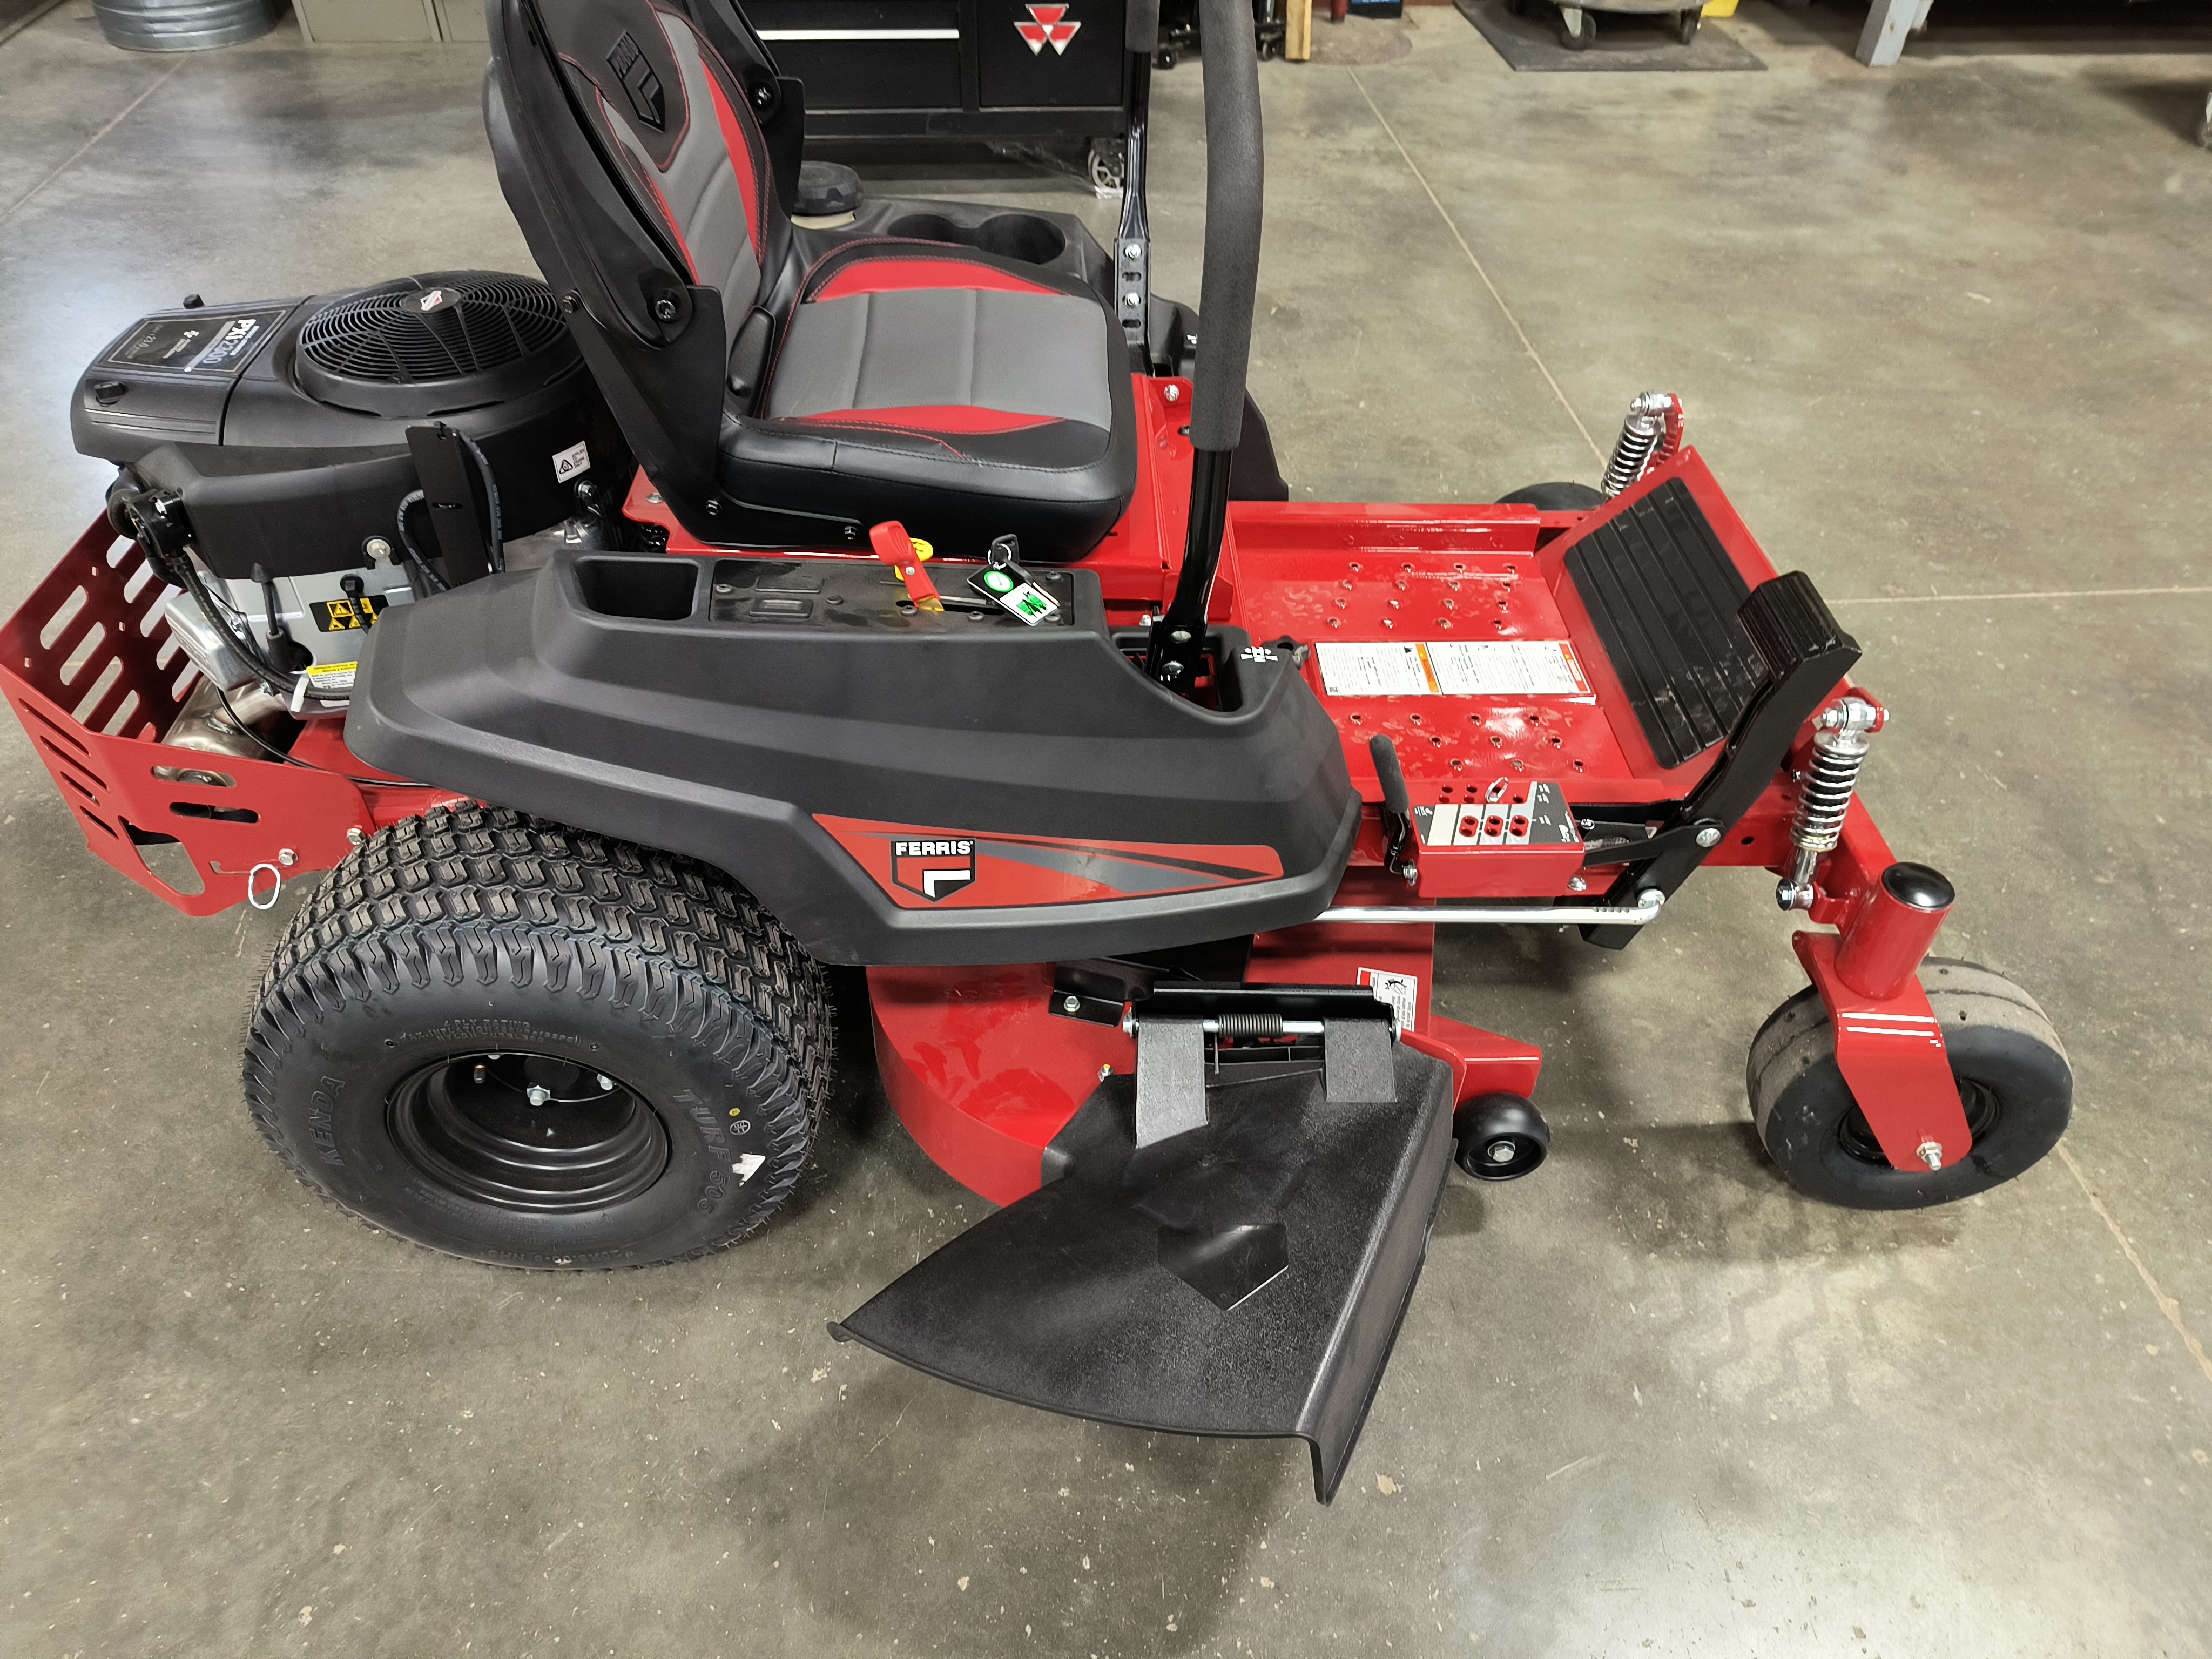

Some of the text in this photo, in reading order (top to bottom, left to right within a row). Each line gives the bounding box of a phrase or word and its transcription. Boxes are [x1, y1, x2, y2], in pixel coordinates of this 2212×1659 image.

[895, 840, 971, 856] FERRIS
[308, 1075, 347, 1167] KENDA
[672, 1089, 732, 1215] TURF 505
